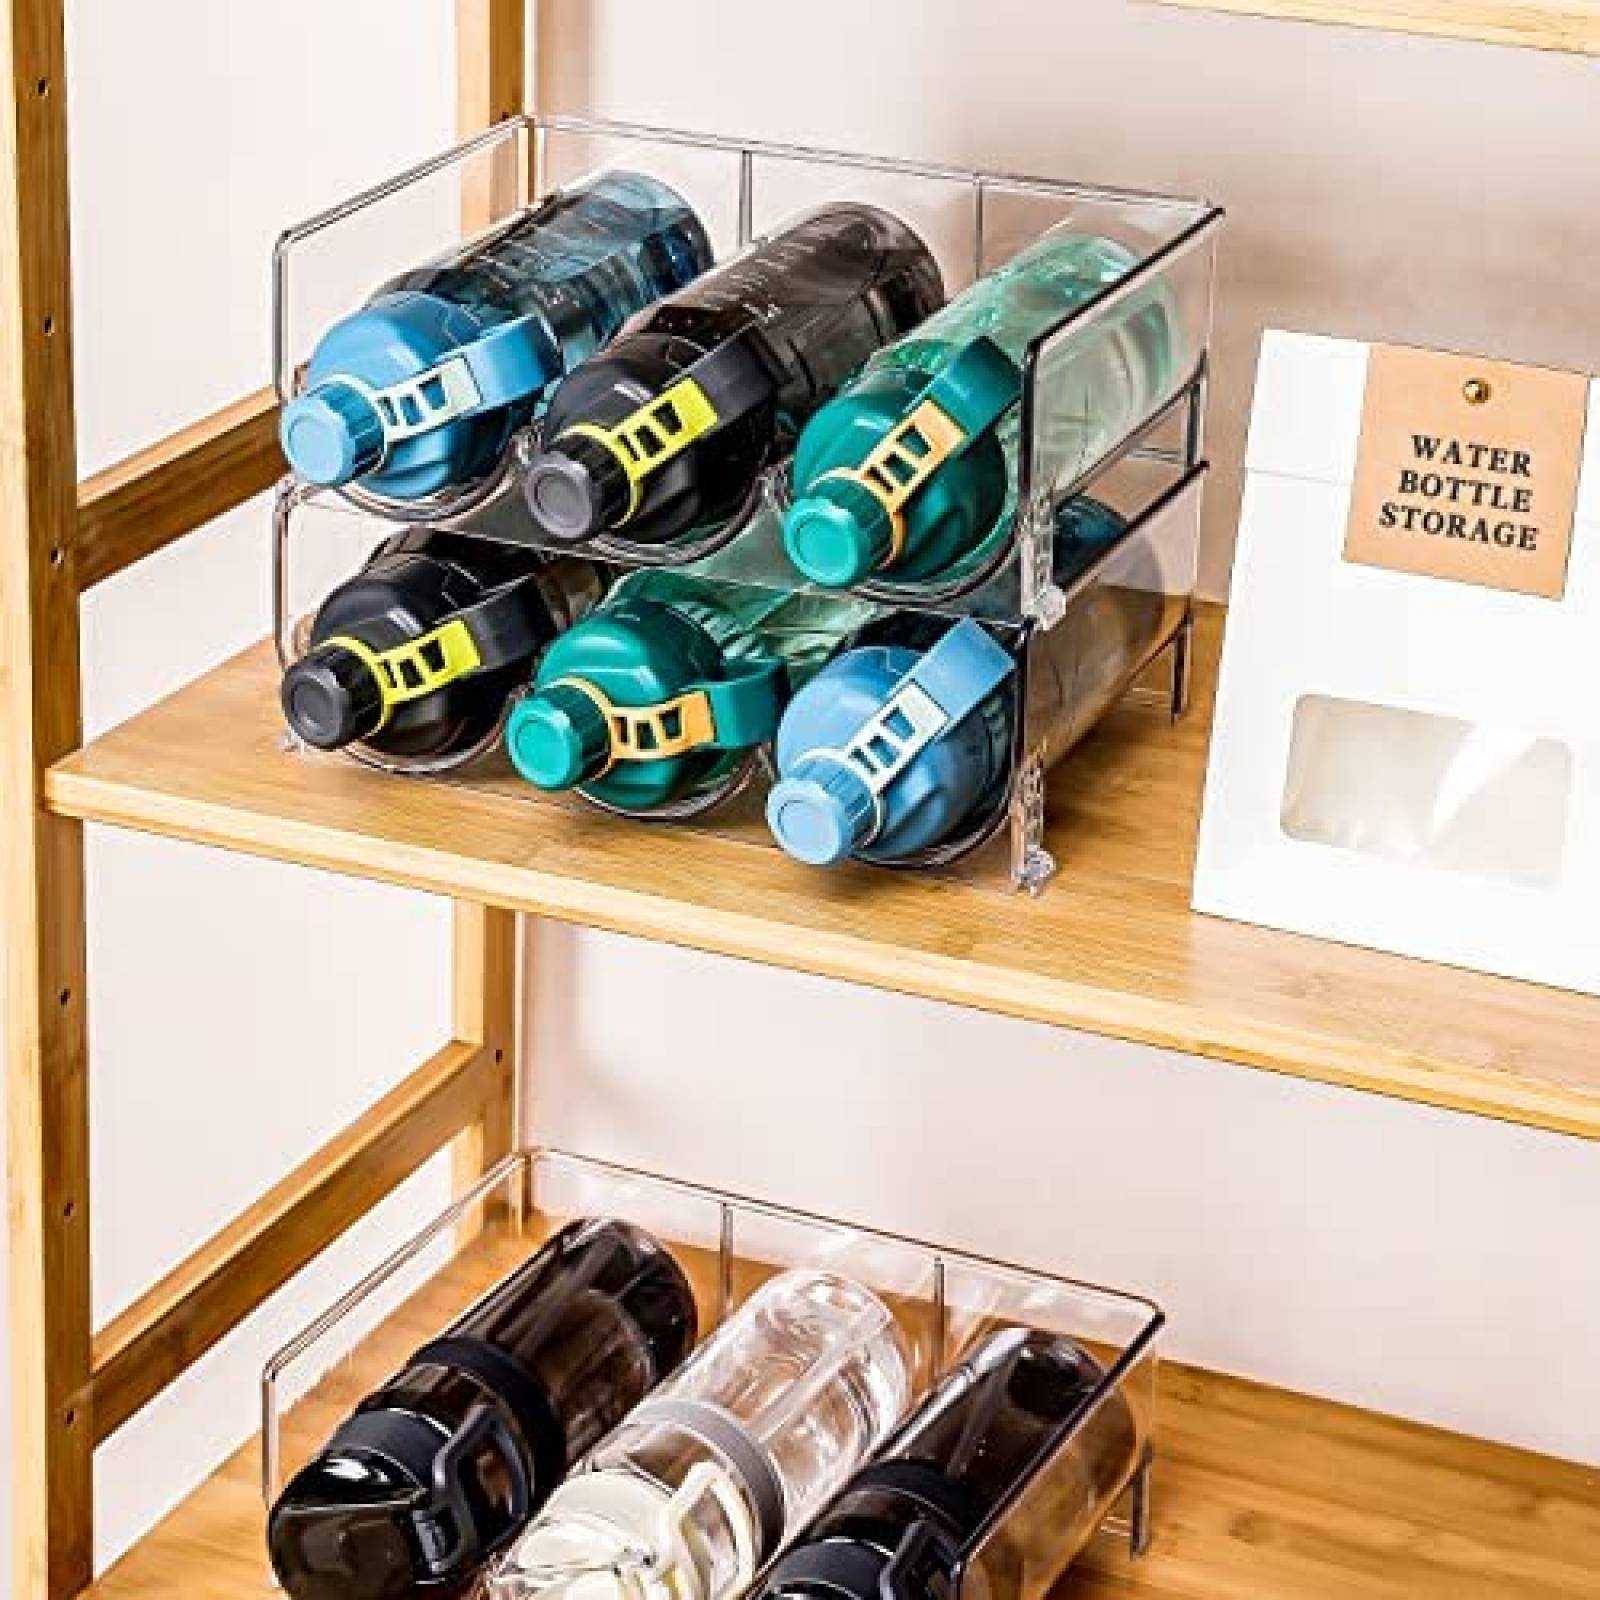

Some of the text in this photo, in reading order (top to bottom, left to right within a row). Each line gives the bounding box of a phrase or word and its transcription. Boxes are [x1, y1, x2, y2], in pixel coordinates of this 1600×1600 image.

[1411, 434, 1531, 477] WATER
[1398, 469, 1534, 513] BOTTLE
[1378, 502, 1540, 551] STORAGE
